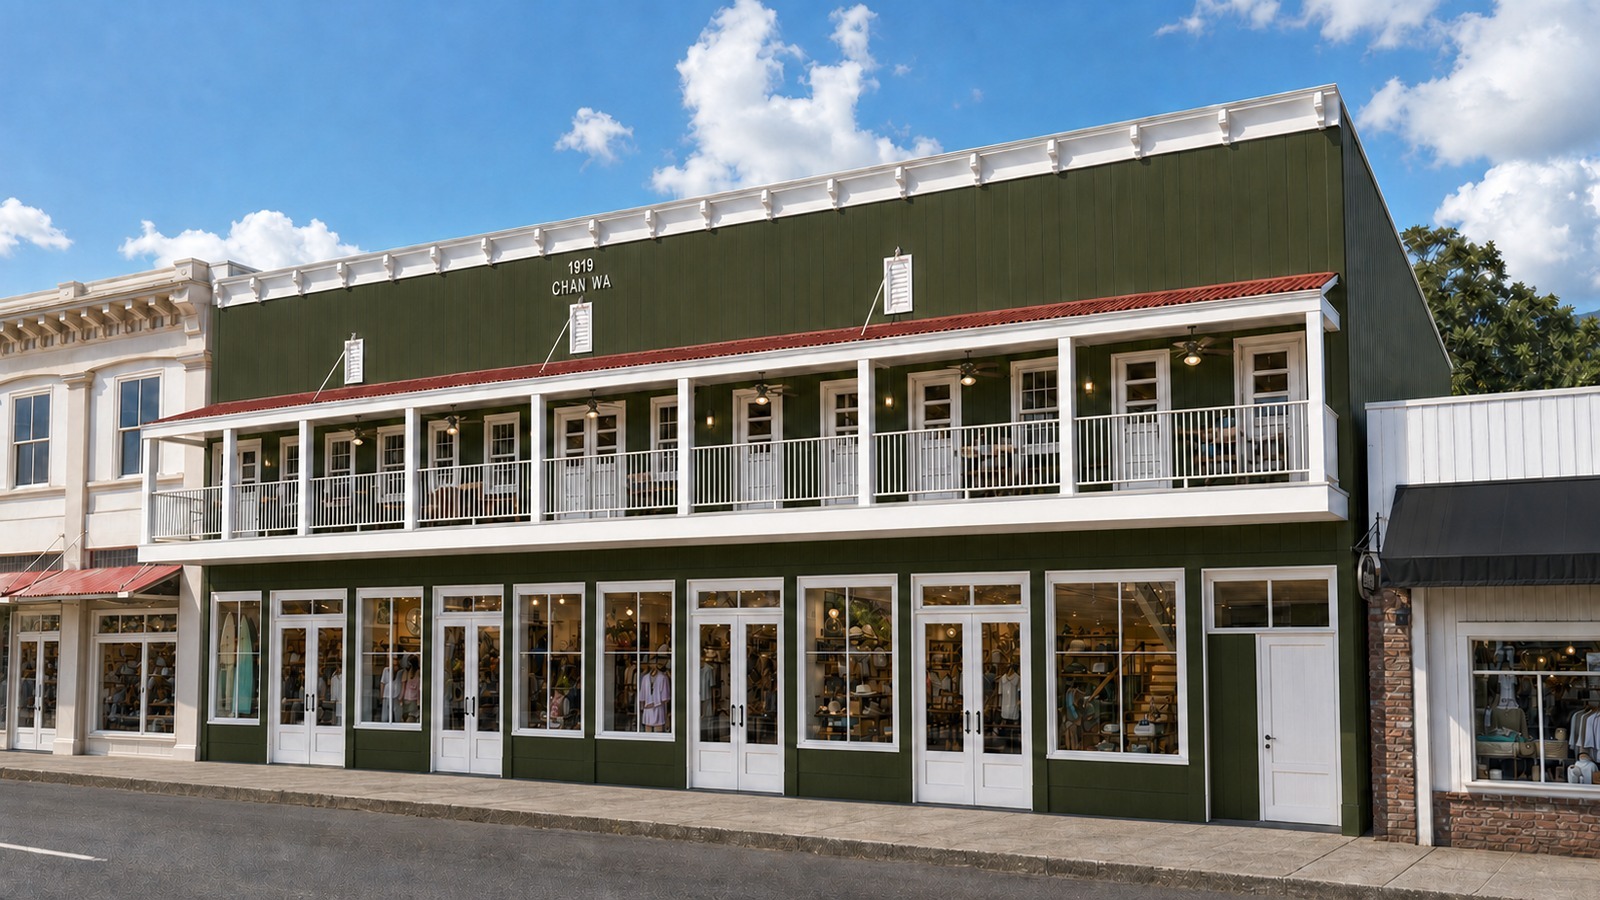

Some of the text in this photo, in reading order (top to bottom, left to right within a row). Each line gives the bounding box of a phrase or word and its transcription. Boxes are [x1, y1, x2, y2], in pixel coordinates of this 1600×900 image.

[568, 258, 593, 274] 1919
[552, 274, 611, 295] CHAN WA
